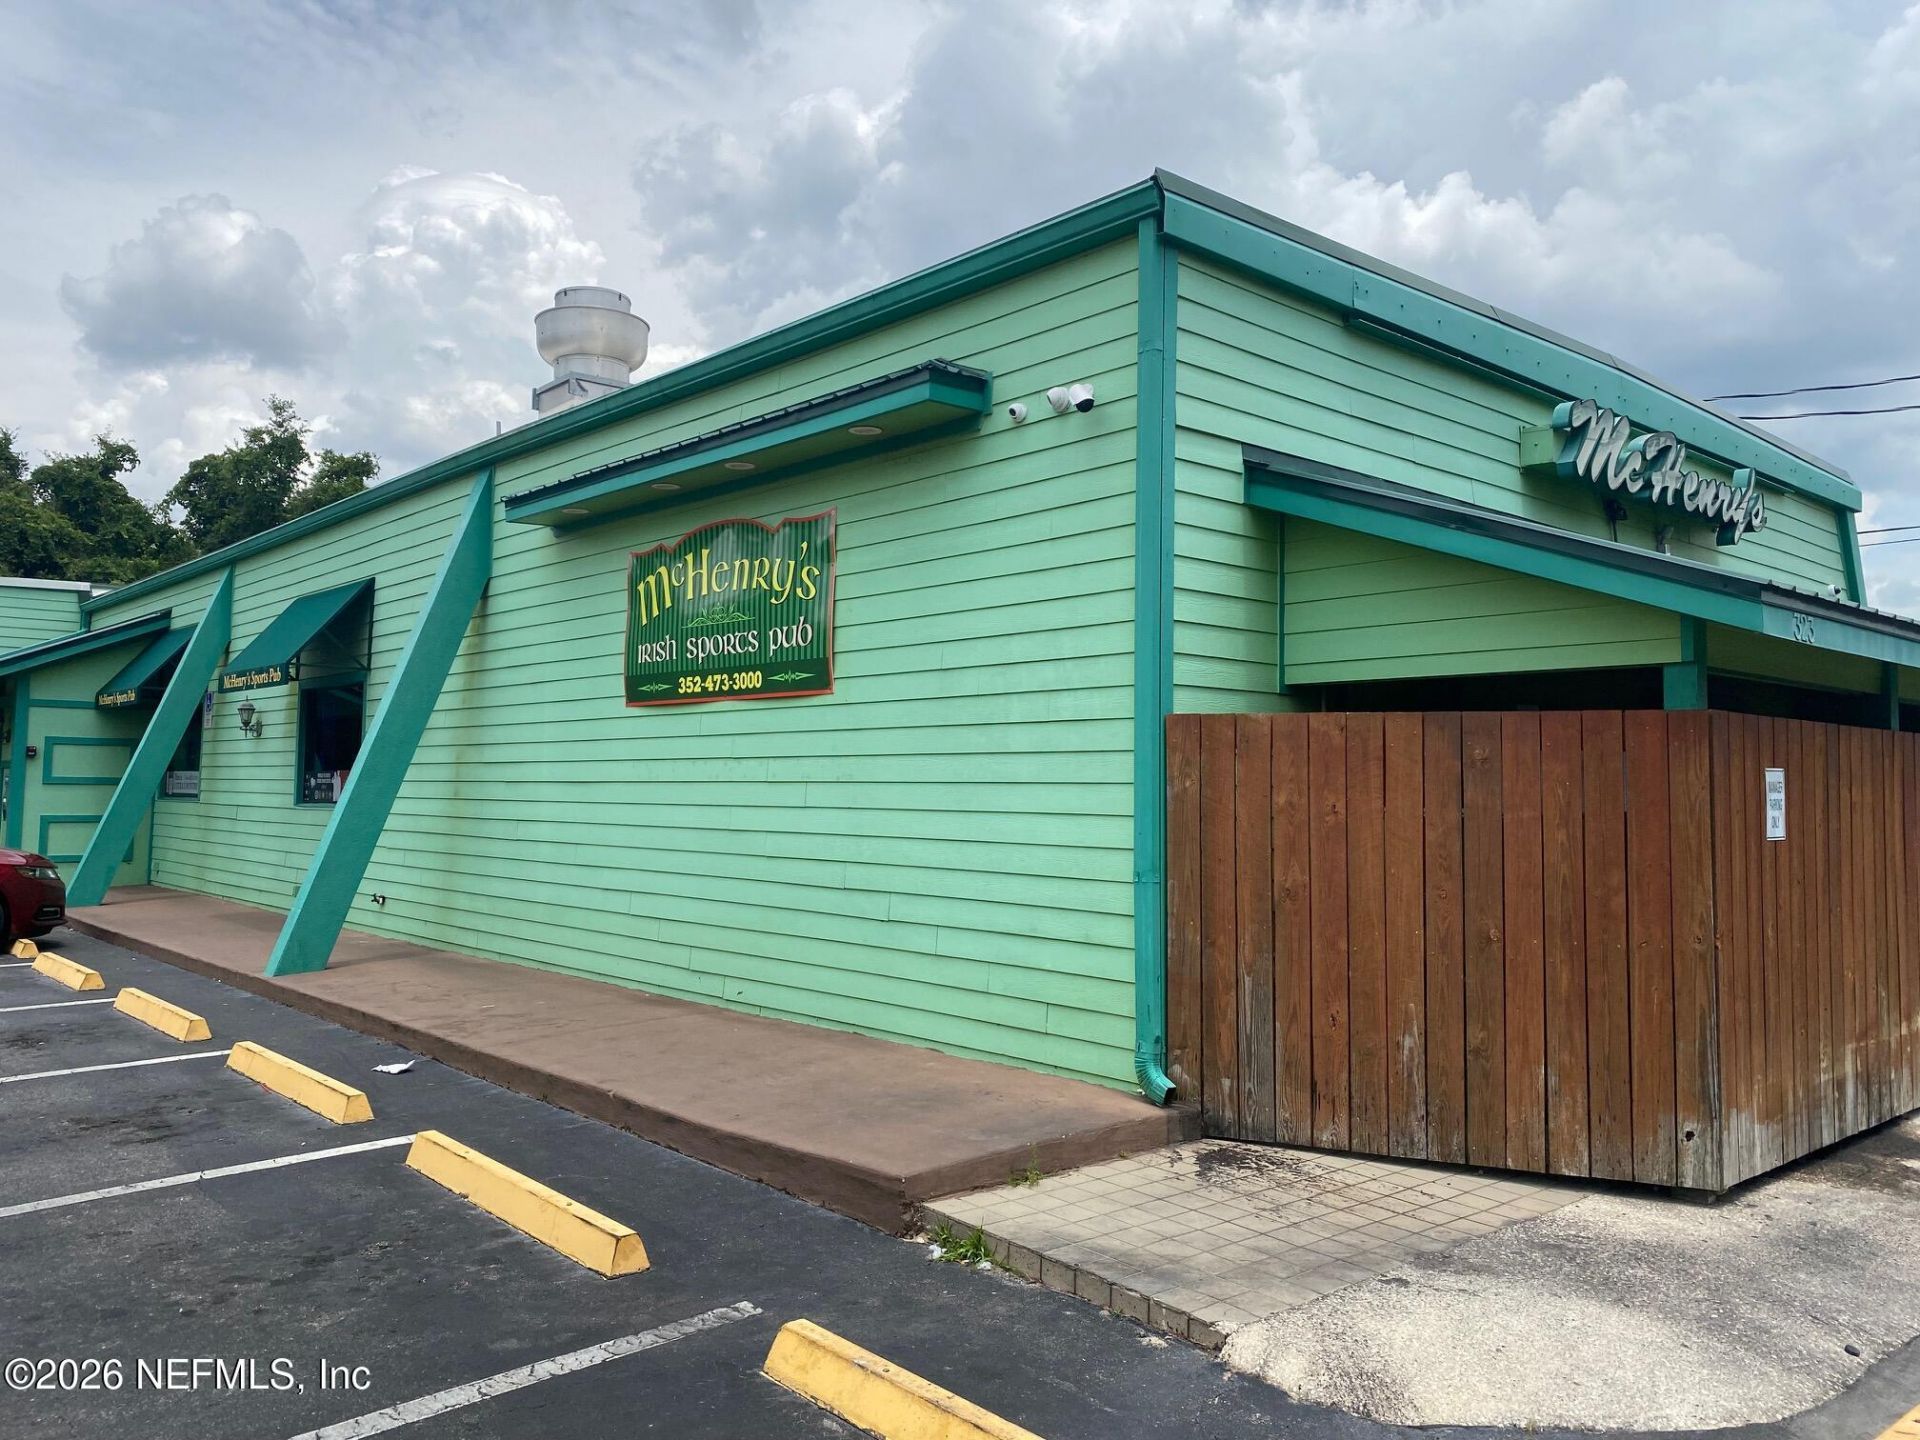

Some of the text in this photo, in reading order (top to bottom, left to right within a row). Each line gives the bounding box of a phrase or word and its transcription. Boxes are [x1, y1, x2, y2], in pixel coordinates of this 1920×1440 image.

[637, 541, 820, 627] McHenry's
[1793, 612, 1815, 643] 323
[251, 671, 269, 688] Sports
[269, 667, 281, 682] Pub
[678, 671, 762, 694] 352-473-3000
